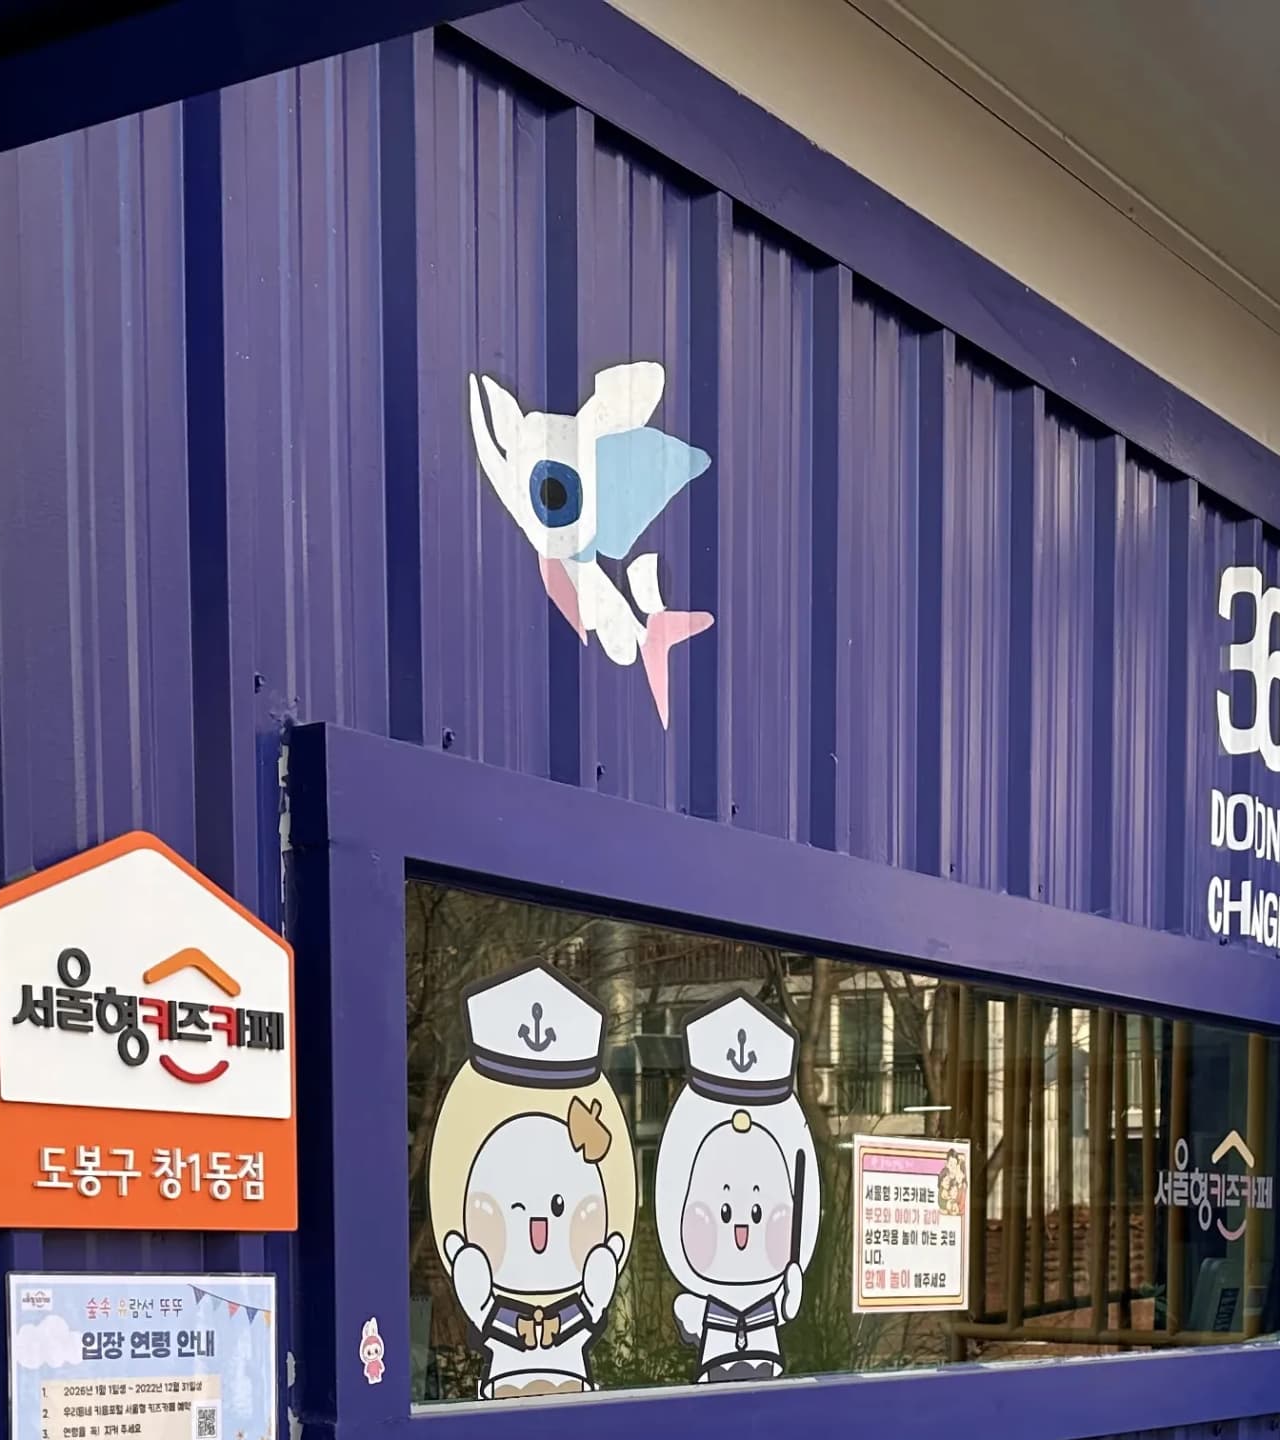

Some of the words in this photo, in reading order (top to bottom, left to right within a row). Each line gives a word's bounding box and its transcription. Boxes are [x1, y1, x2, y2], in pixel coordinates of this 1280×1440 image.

[12, 947, 285, 1067] 서울형키즈카페
[33, 1144, 142, 1198] 도봉구
[151, 1147, 265, 1202] 창1동점
[1154, 1138, 1273, 1231] 서울형키즈카페
[86, 1297, 111, 1319] 숲속
[118, 1297, 154, 1319] 유람선
[160, 1298, 183, 1318] 뚜뚜
[81, 1331, 125, 1360] 입장
[130, 1330, 170, 1359] 연령
[177, 1330, 215, 1358] 안내
[64, 1384, 93, 1396] 2026년
